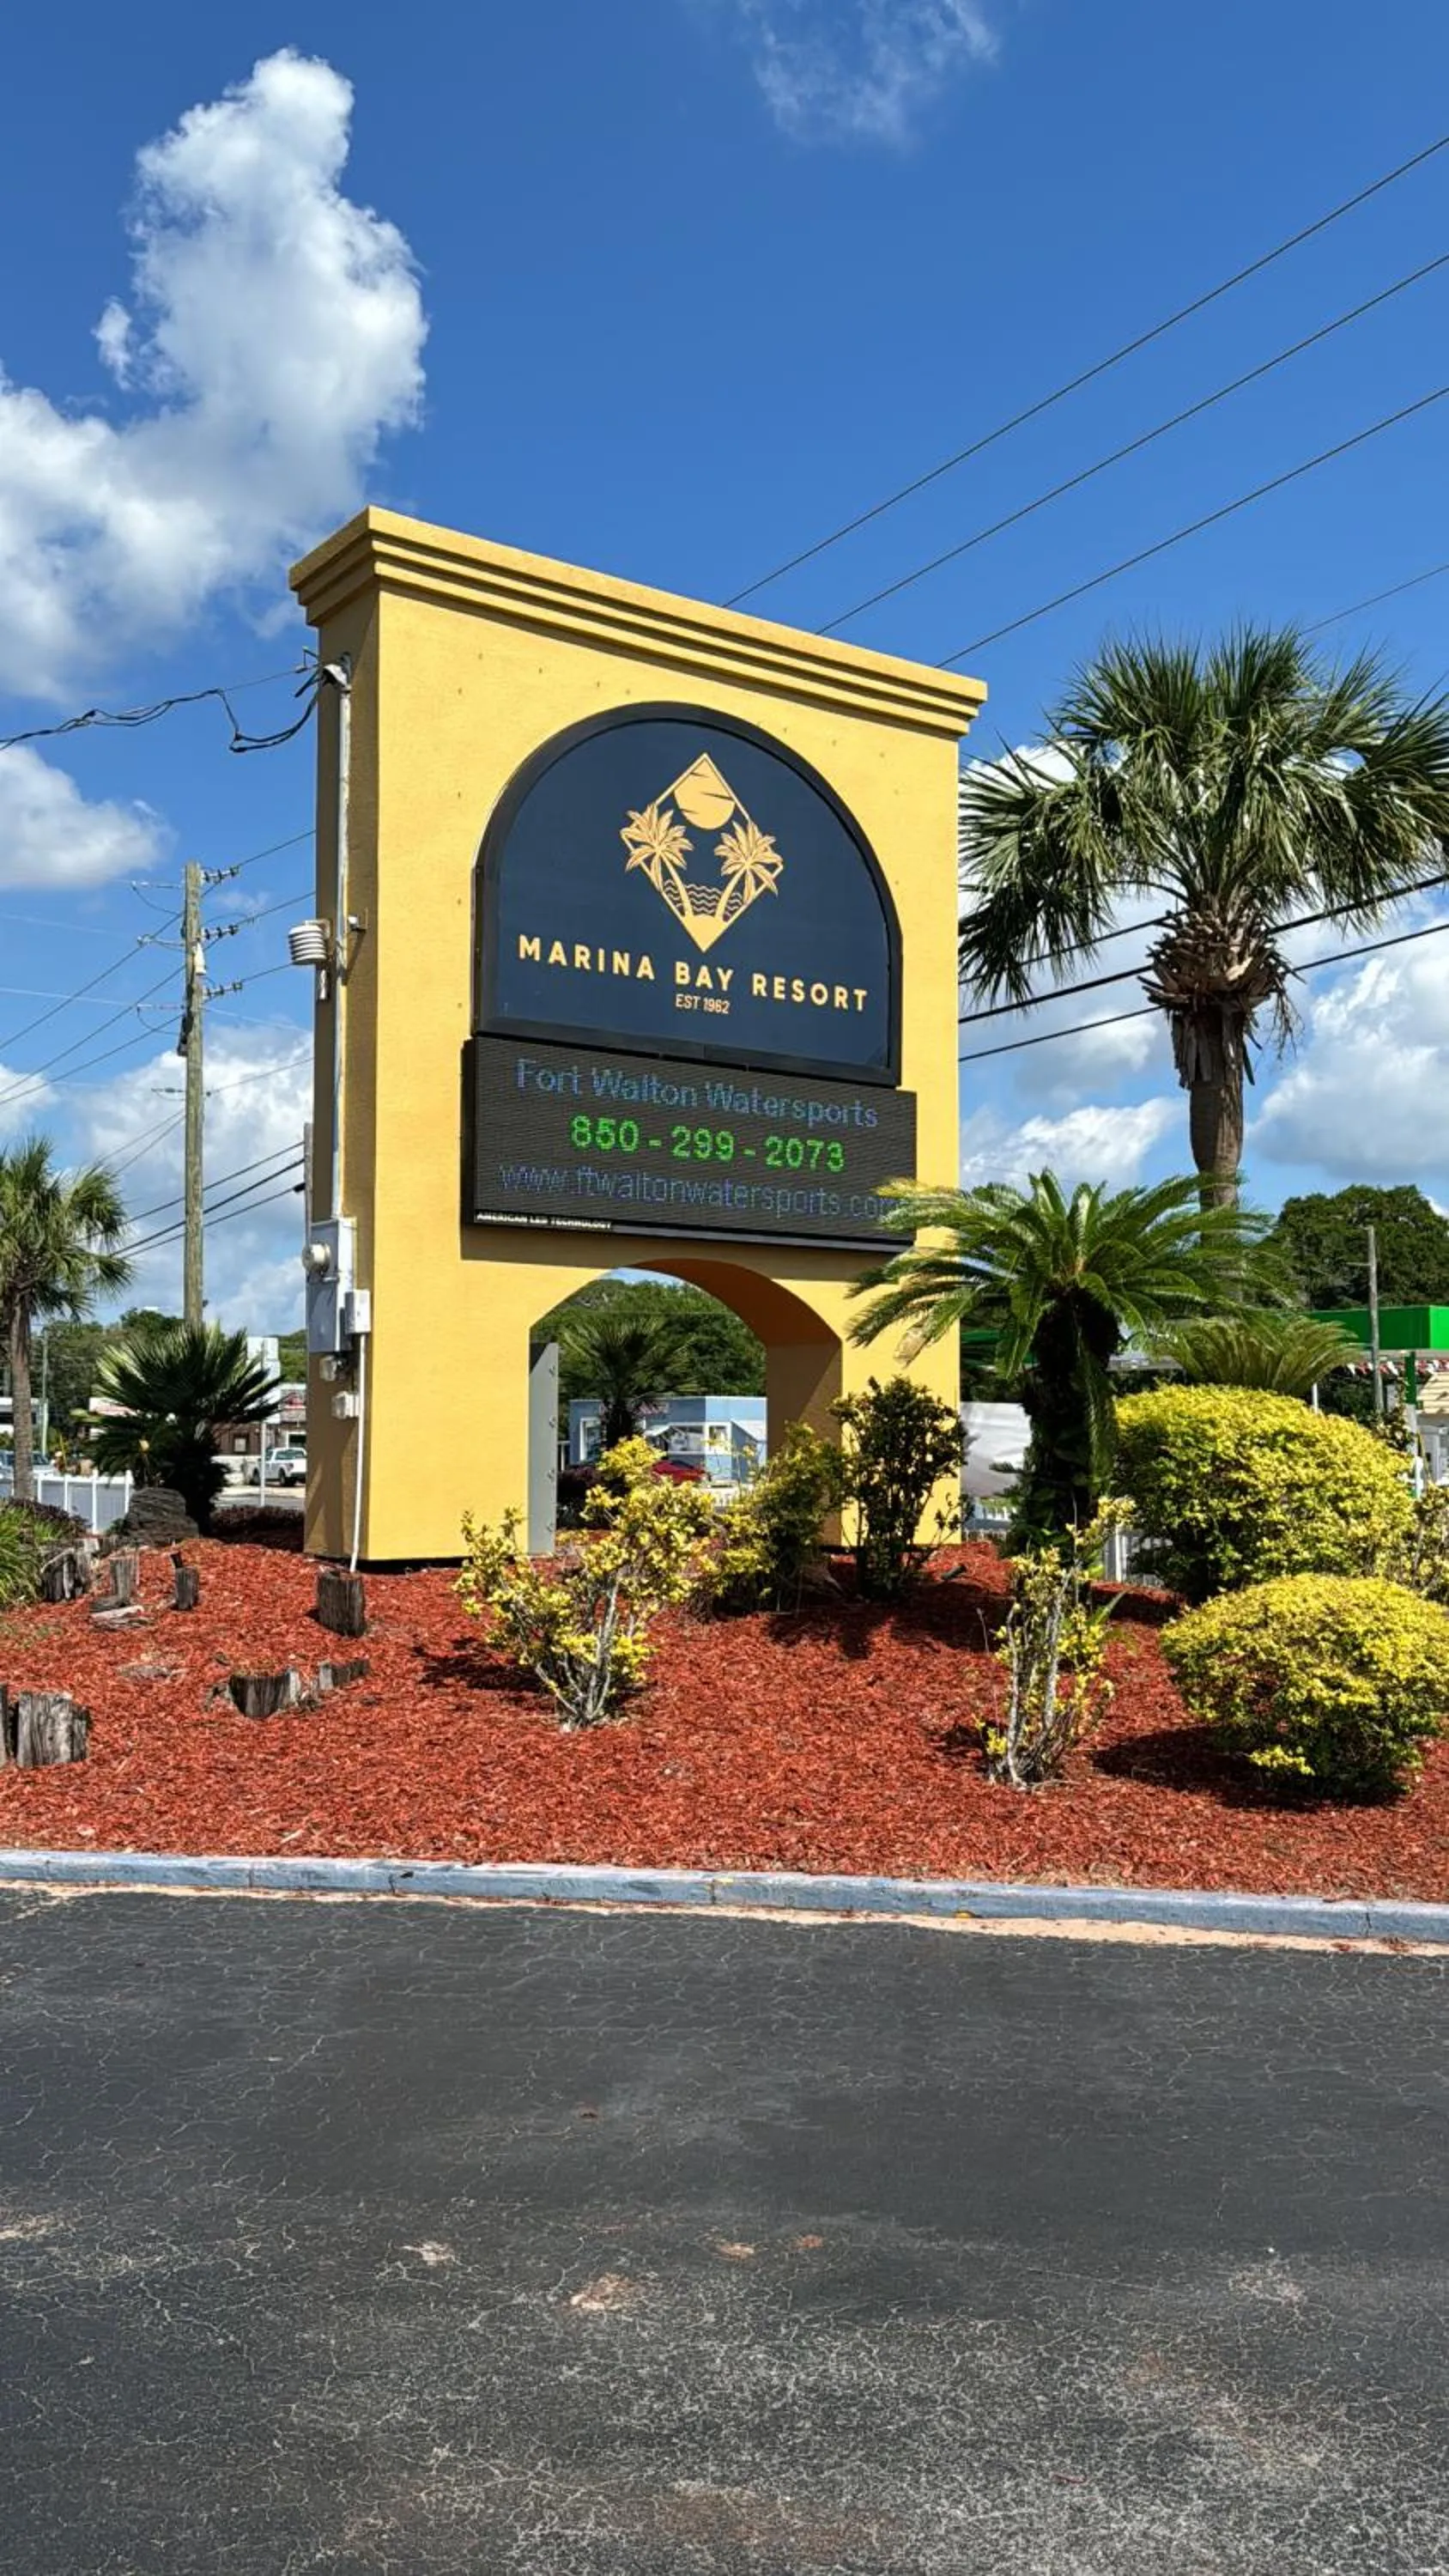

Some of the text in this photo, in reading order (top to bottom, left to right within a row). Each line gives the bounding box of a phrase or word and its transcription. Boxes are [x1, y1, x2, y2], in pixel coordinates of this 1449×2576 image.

[518, 933, 868, 1012] MARINA BAY RESORT
[675, 993, 730, 1014] EST 1962
[515, 1058, 879, 1127] Fort Walton Watersports
[570, 1115, 640, 1151] 850
[671, 1126, 735, 1161] 299
[764, 1135, 846, 1172] 2073
